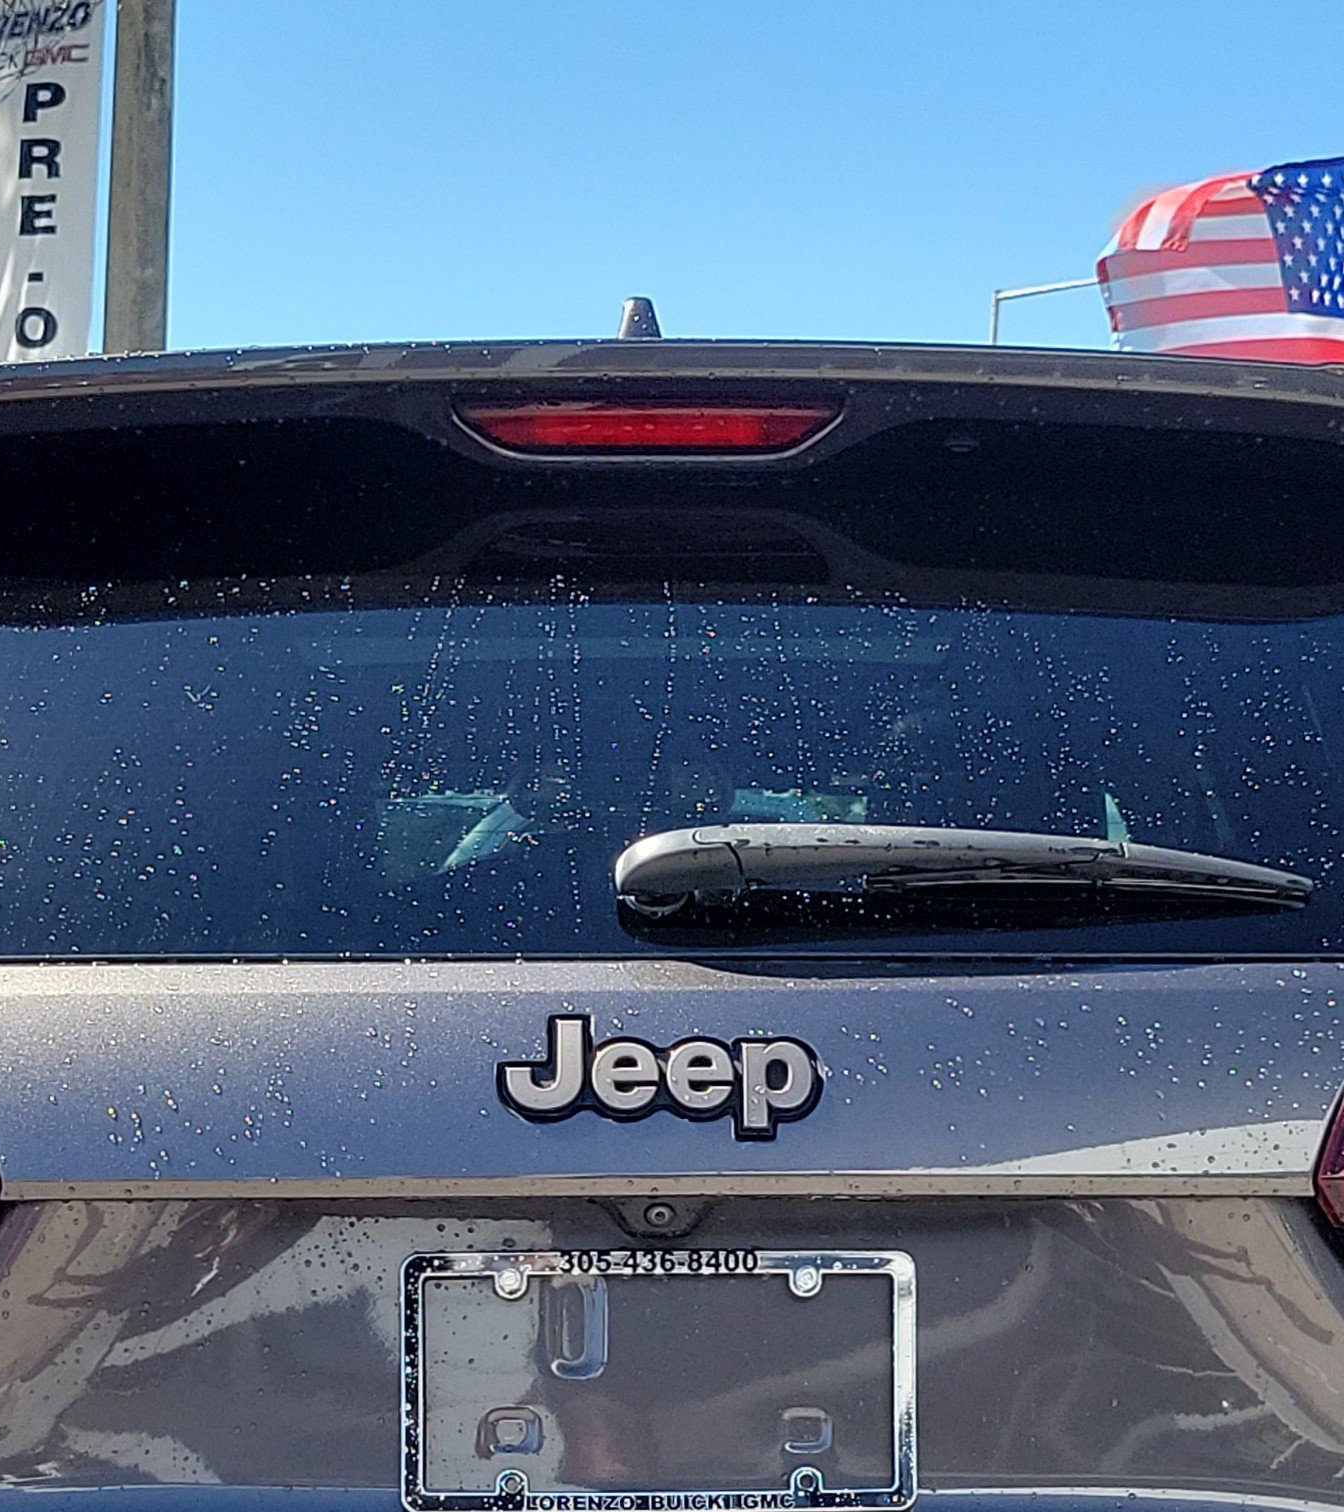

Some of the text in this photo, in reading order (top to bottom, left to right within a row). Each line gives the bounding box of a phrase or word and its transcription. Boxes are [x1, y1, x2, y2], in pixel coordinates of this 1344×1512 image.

[22, 44, 90, 66] GMC
[500, 1016, 822, 1138] Jeep
[559, 1250, 758, 1273] 305-436-8400
[525, 1493, 794, 1511] LORENZO BUICK GMC
